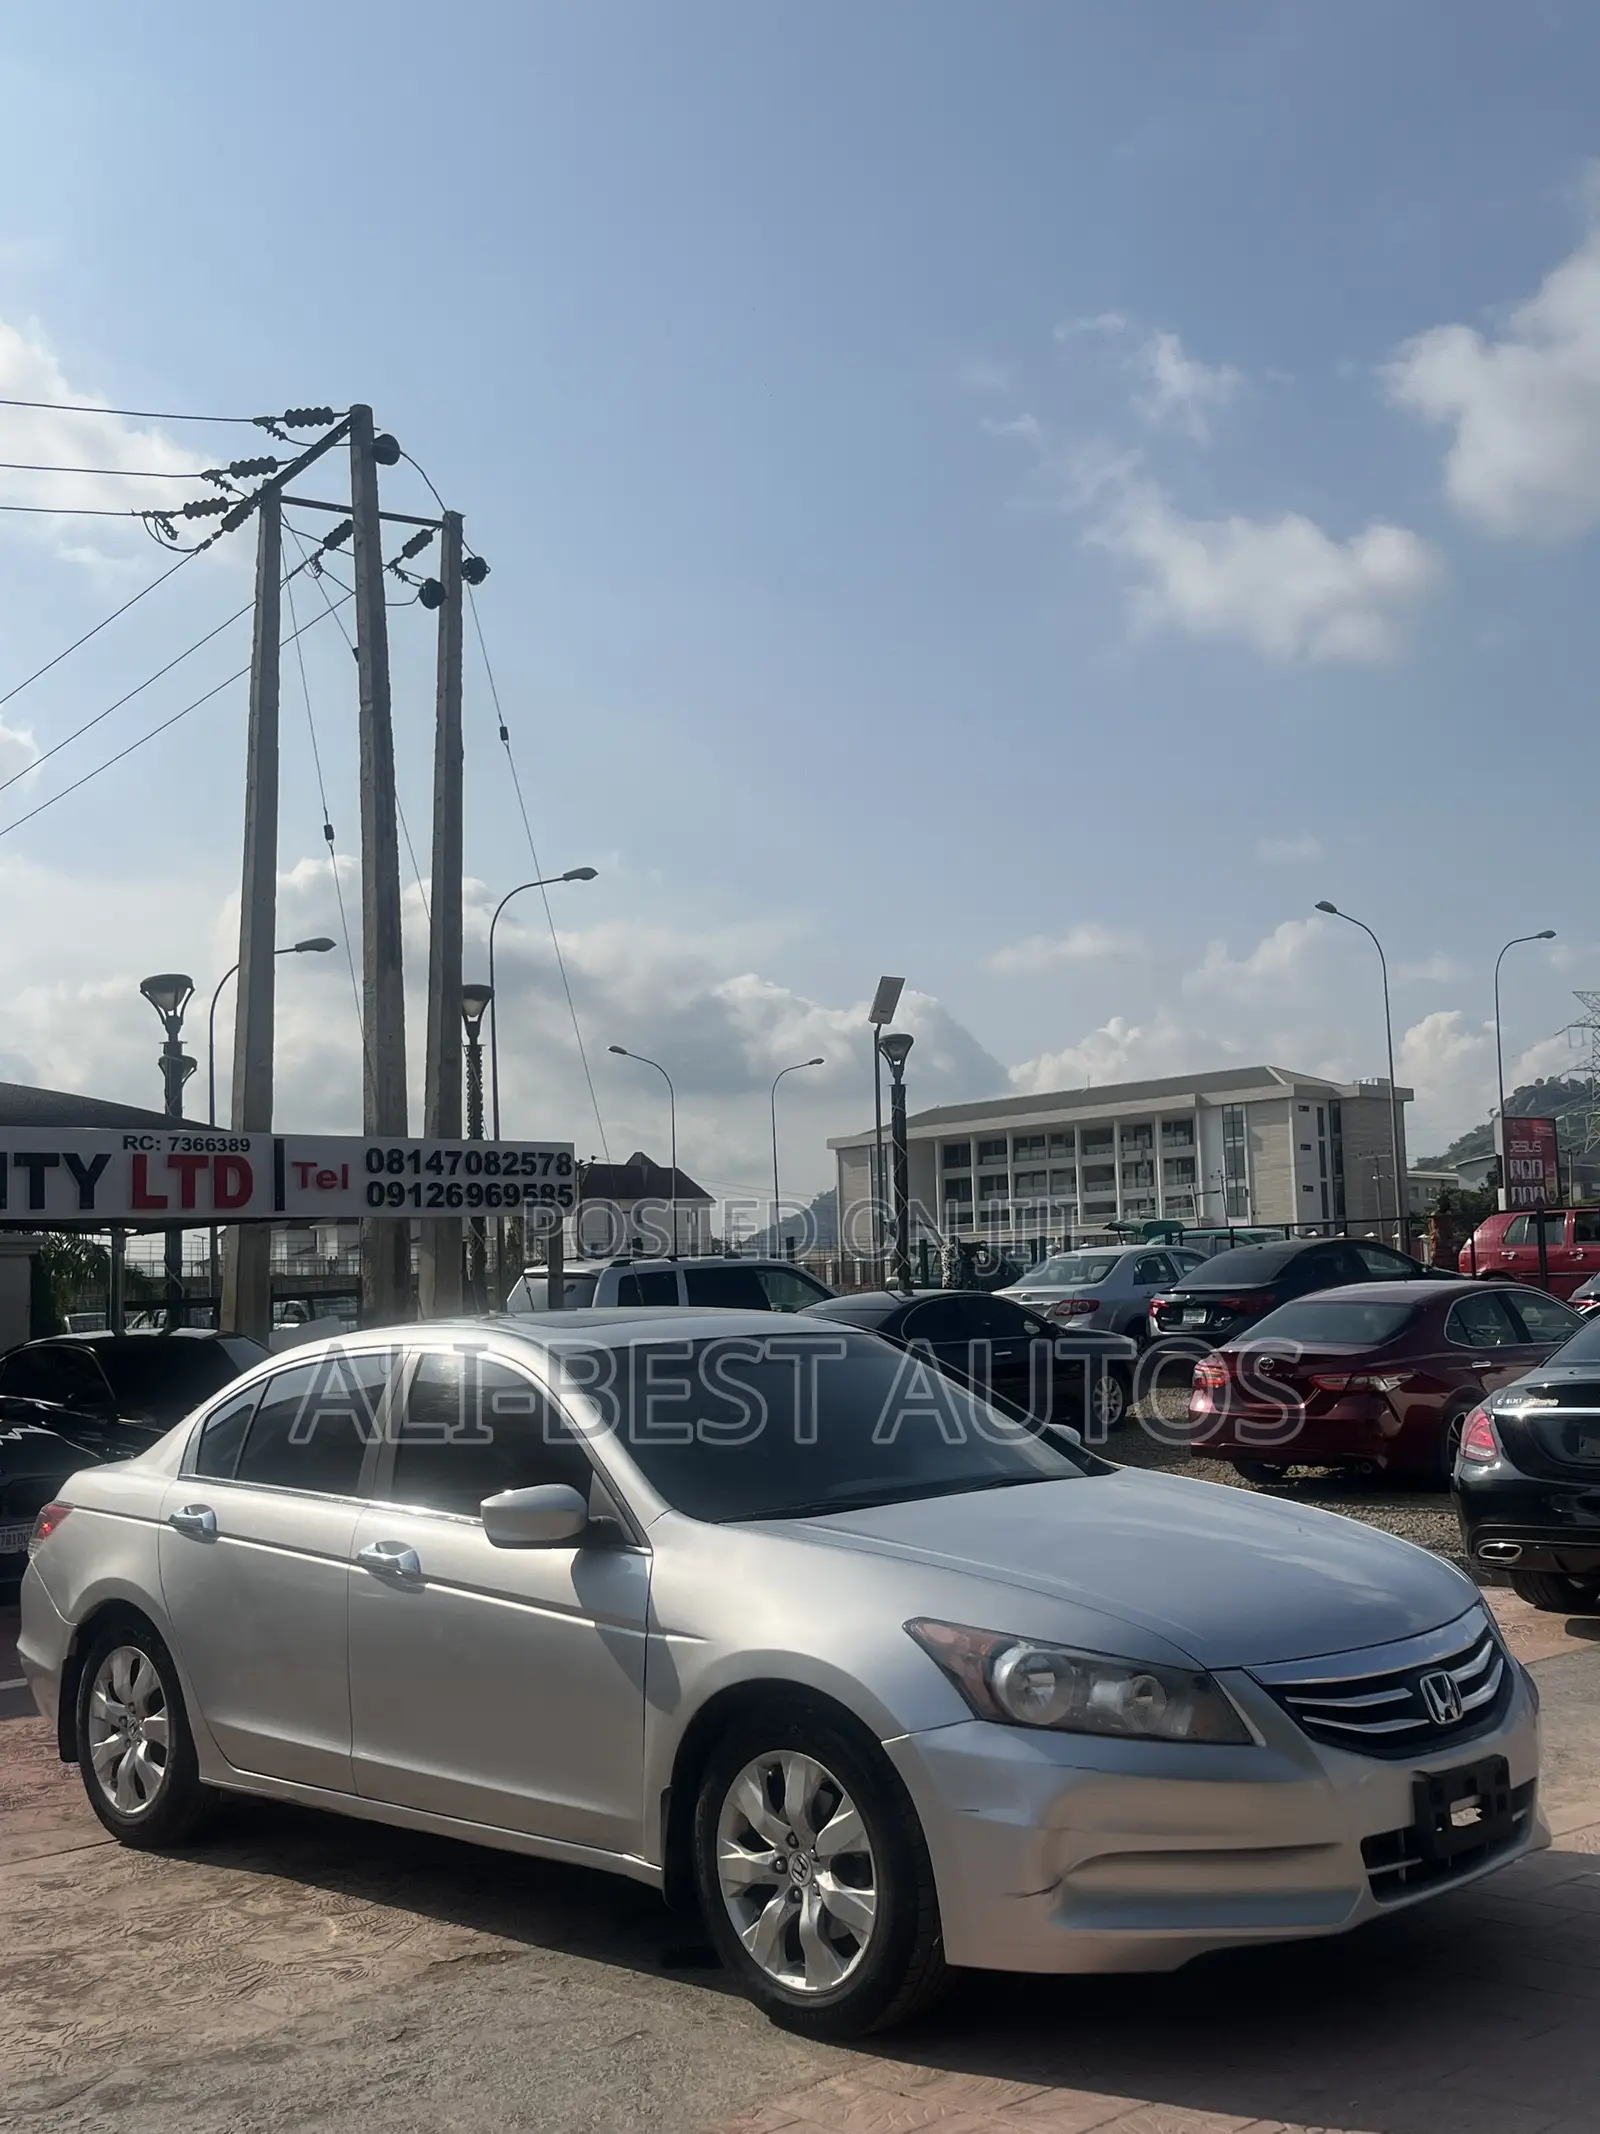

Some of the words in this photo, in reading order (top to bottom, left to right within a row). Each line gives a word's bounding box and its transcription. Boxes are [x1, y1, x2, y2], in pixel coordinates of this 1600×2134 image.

[123, 1135, 161, 1151] RC:
[168, 1136, 251, 1152] 7366389
[292, 1161, 349, 1190] Tel
[365, 1147, 572, 1176] 08147082578
[131, 1153, 254, 1210] LTD
[366, 1180, 573, 1208] 09126969585
